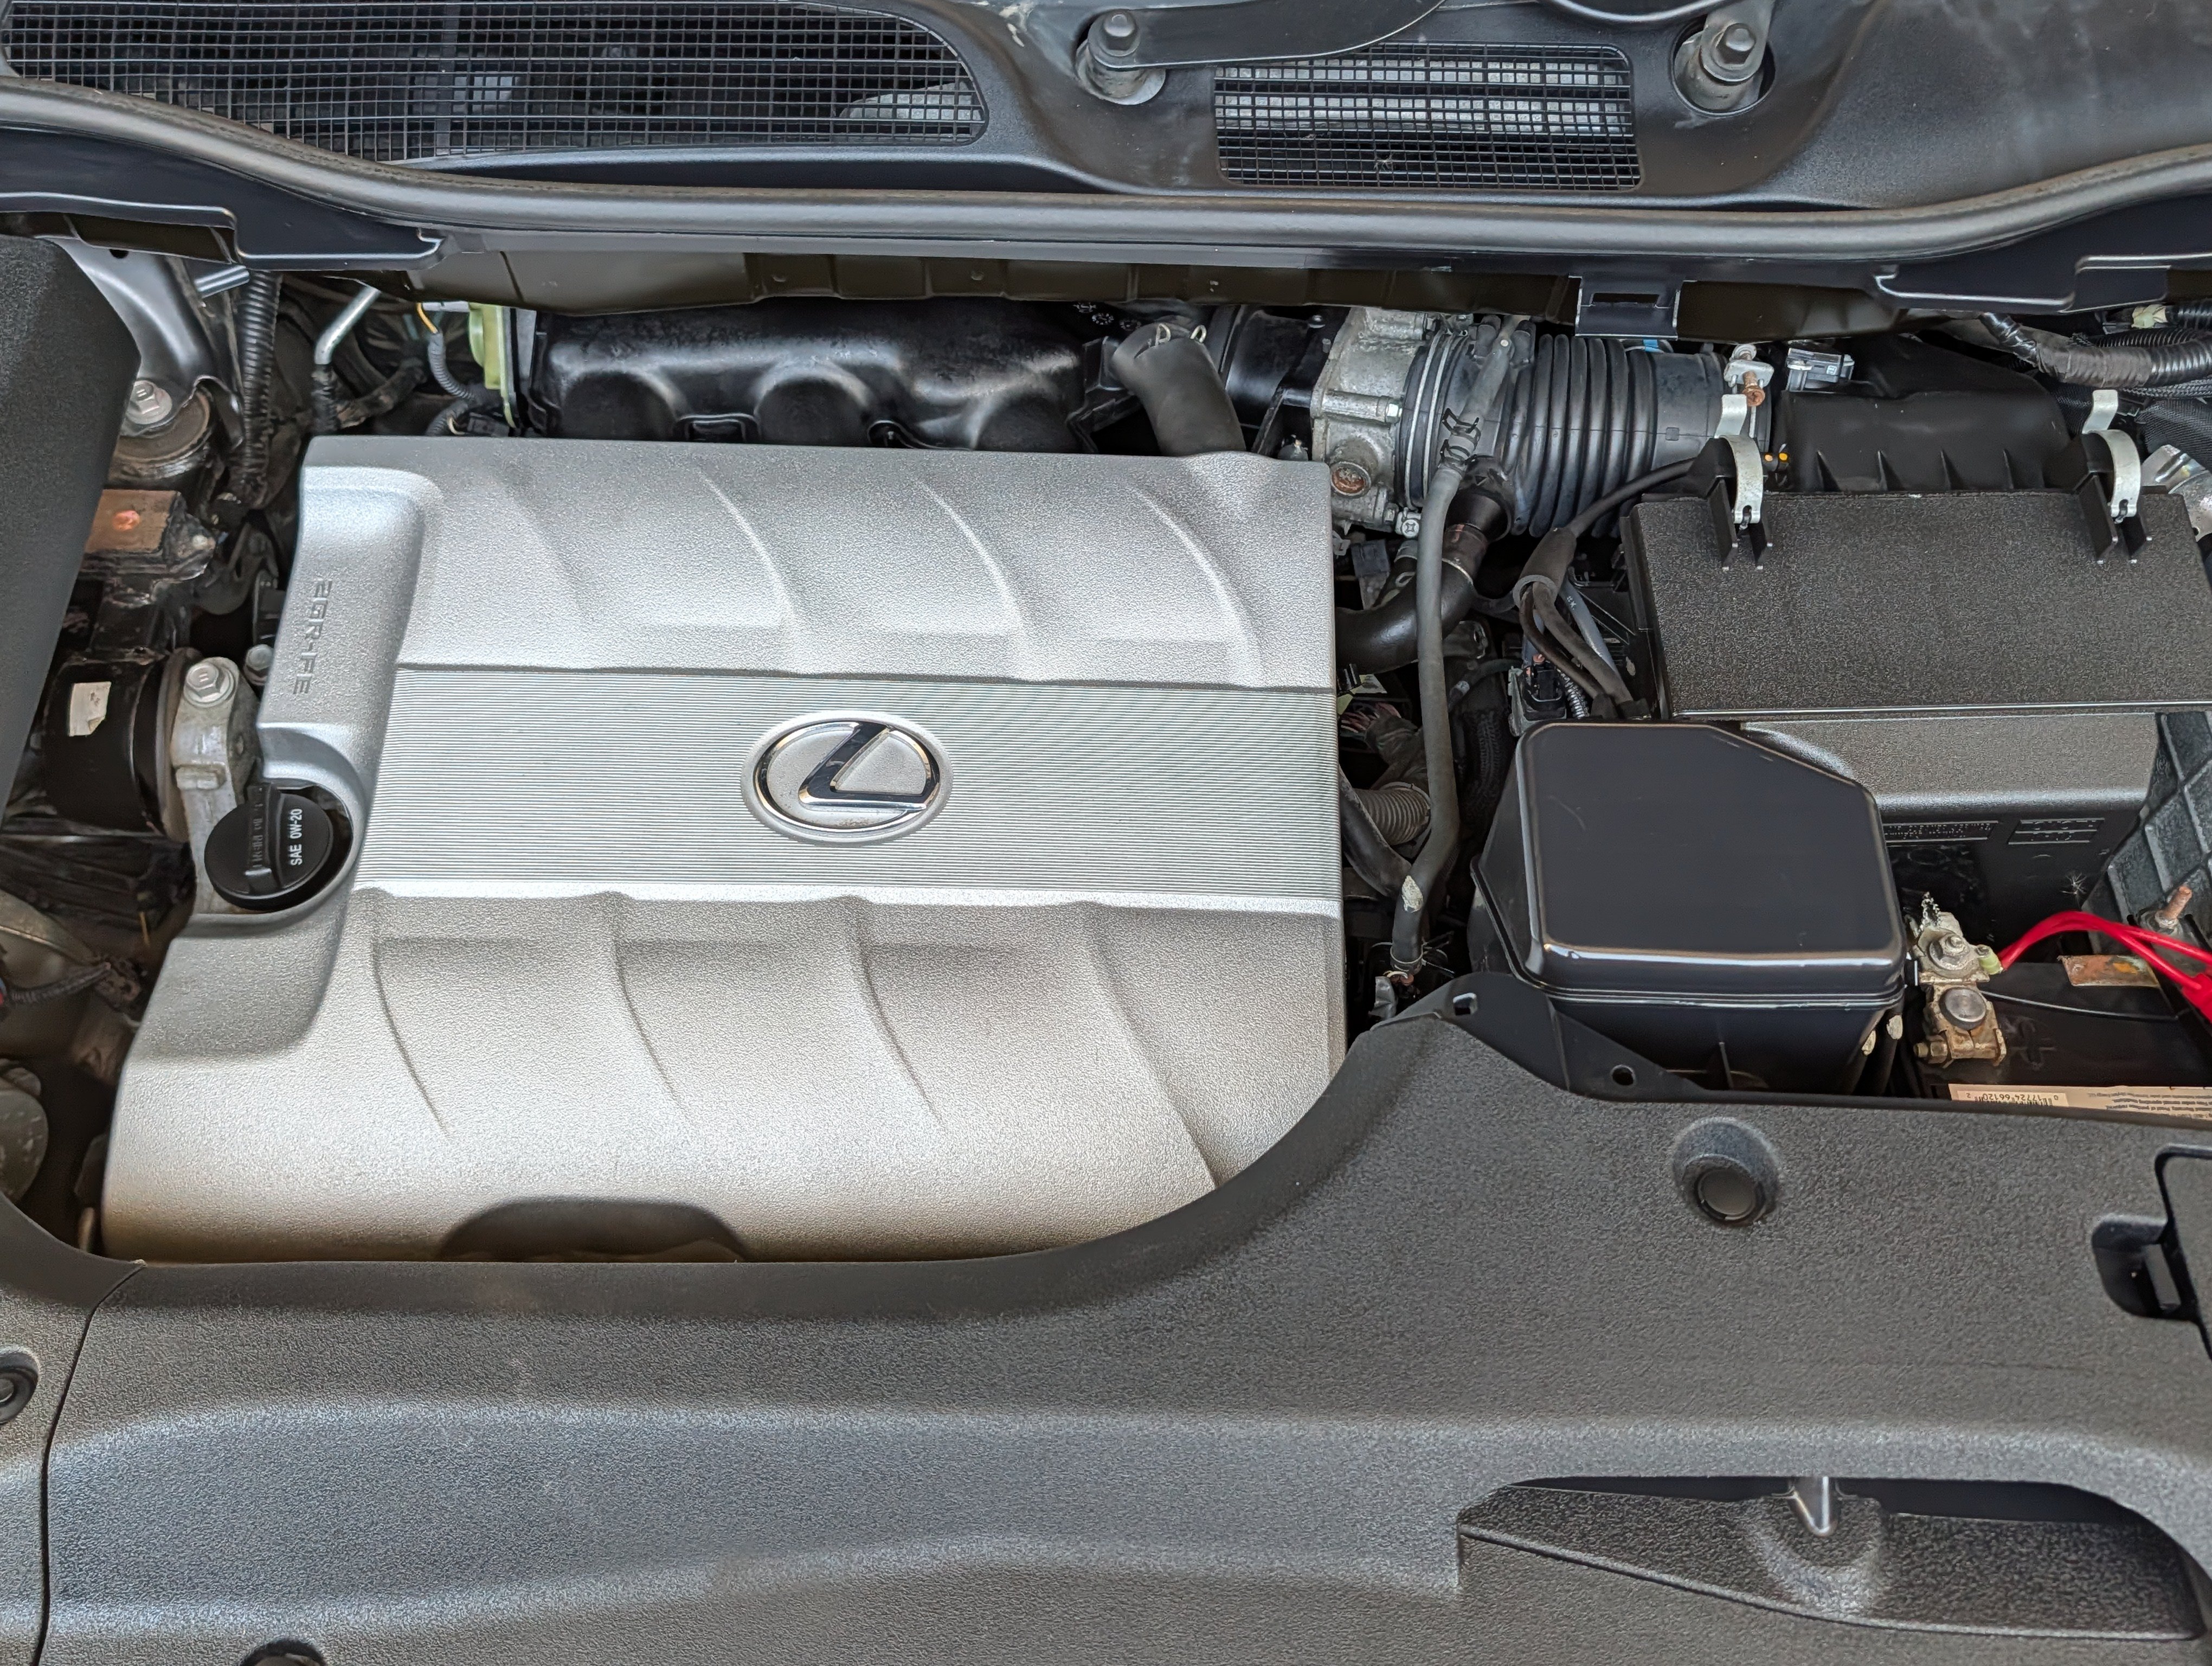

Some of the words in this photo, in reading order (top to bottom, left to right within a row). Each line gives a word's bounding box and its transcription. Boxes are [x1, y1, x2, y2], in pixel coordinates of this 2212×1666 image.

[293, 578, 333, 694] 2GR-FE
[289, 808, 303, 839] 0W-20
[289, 844, 303, 866] SAE
[1983, 1093, 2010, 1101] 66120
